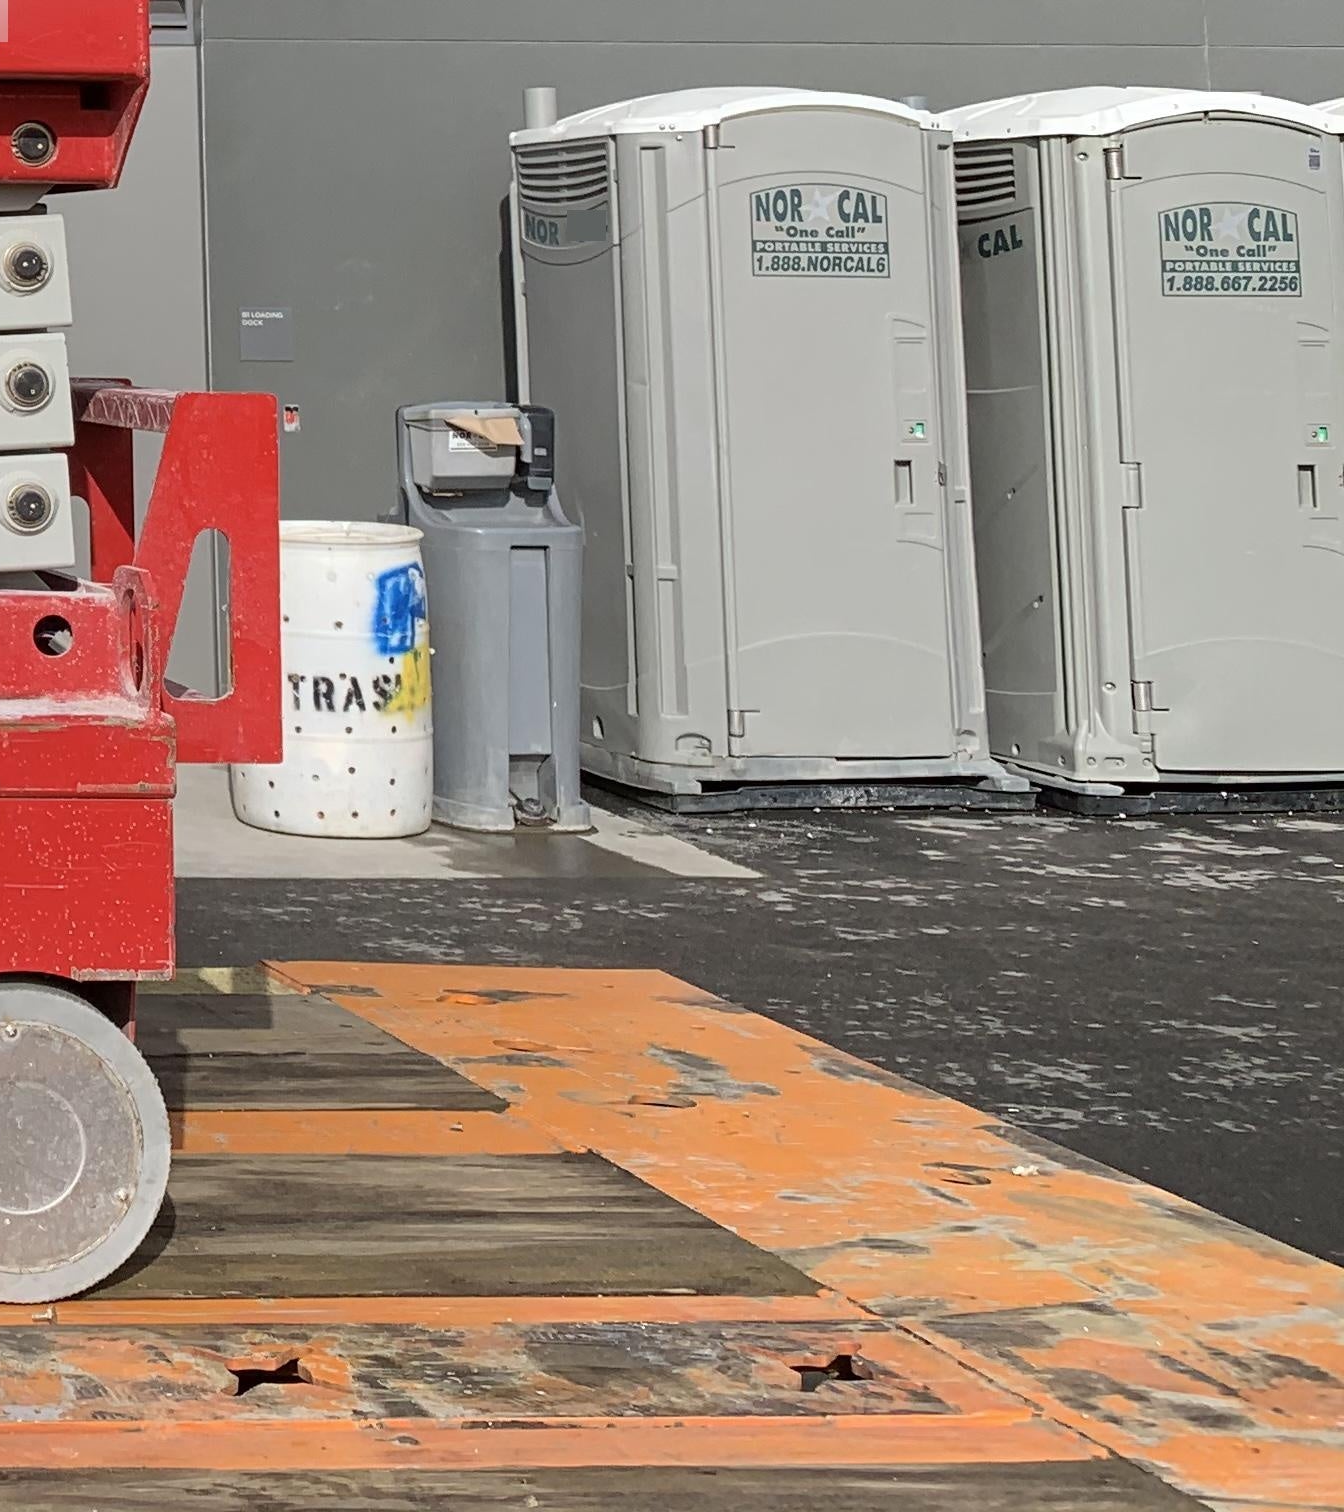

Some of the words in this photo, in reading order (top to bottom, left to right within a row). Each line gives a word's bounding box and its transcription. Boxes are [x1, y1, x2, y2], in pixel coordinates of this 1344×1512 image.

[755, 189, 804, 222] NOR
[838, 190, 882, 223] CAL
[524, 213, 559, 245] NOR
[1164, 208, 1214, 241] NOR
[1248, 208, 1293, 242] CAL
[756, 242, 821, 252] PORTABLE
[827, 242, 885, 253] SERVICES
[978, 225, 1022, 258] CAL
[757, 255, 886, 273] 1.888.NORCAL6
[1166, 262, 1232, 271] PORTABLE
[1238, 262, 1296, 271] SERVICES
[1166, 276, 1298, 292] 1.888.667.2256
